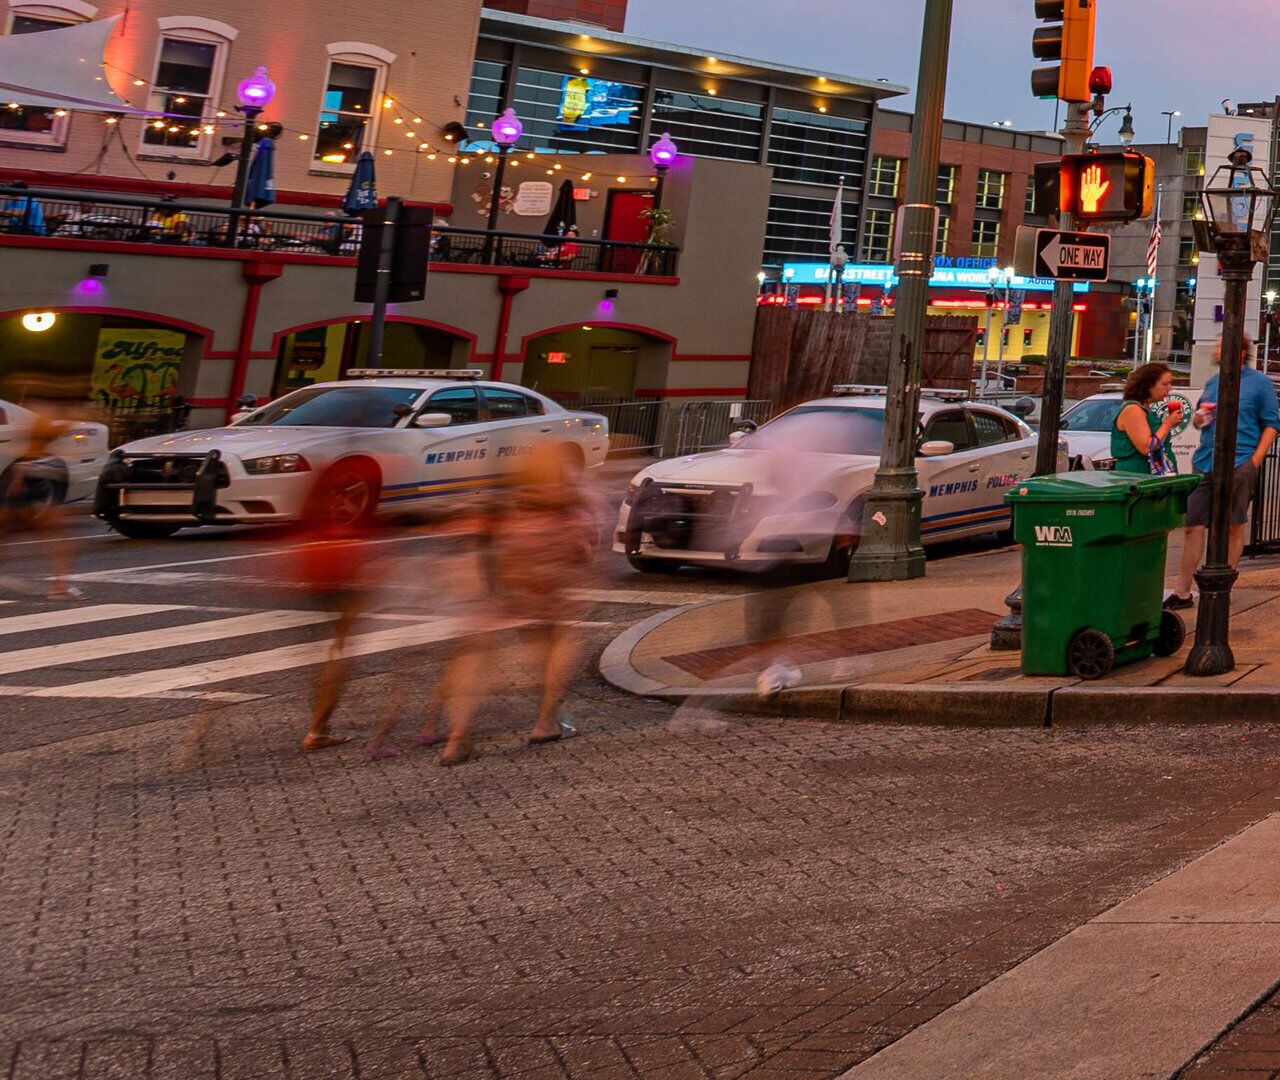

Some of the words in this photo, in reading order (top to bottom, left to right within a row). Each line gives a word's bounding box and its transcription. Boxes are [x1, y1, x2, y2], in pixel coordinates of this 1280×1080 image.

[954, 256, 998, 269] OFFICE
[1060, 246, 1080, 265] ONE
[1083, 248, 1102, 266] WAY
[1172, 443, 1197, 451] everages
[425, 448, 487, 465] MEMPHIS
[929, 479, 979, 498] MEMPHIS
[985, 473, 1019, 489] POLICE
[1034, 525, 1073, 543] WM
